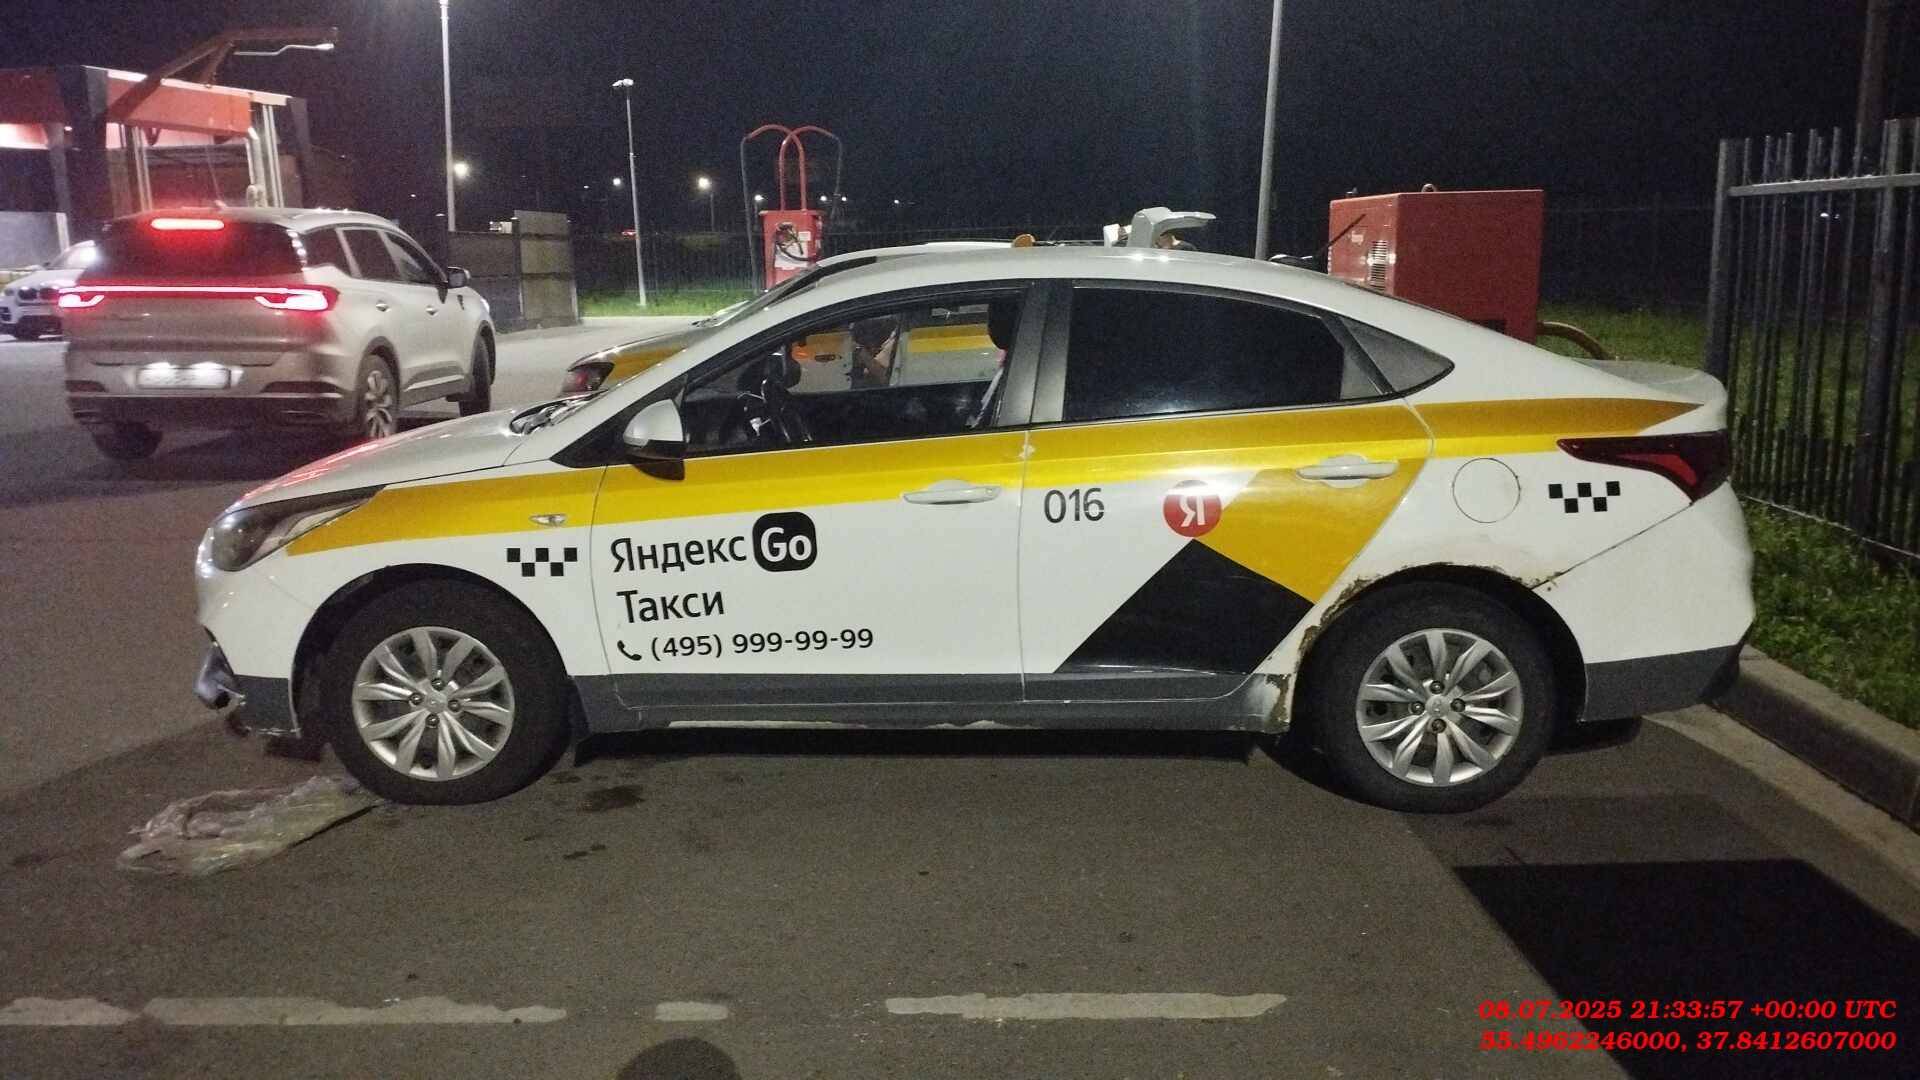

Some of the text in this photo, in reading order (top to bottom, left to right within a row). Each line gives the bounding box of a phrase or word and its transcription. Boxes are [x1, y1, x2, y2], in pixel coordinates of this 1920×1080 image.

[1044, 487, 1105, 523] 016
[1178, 489, 1206, 527] Я
[610, 526, 812, 573] Яндекс Go
[616, 590, 725, 623] Такси
[651, 628, 874, 661] (495) 999-99-99
